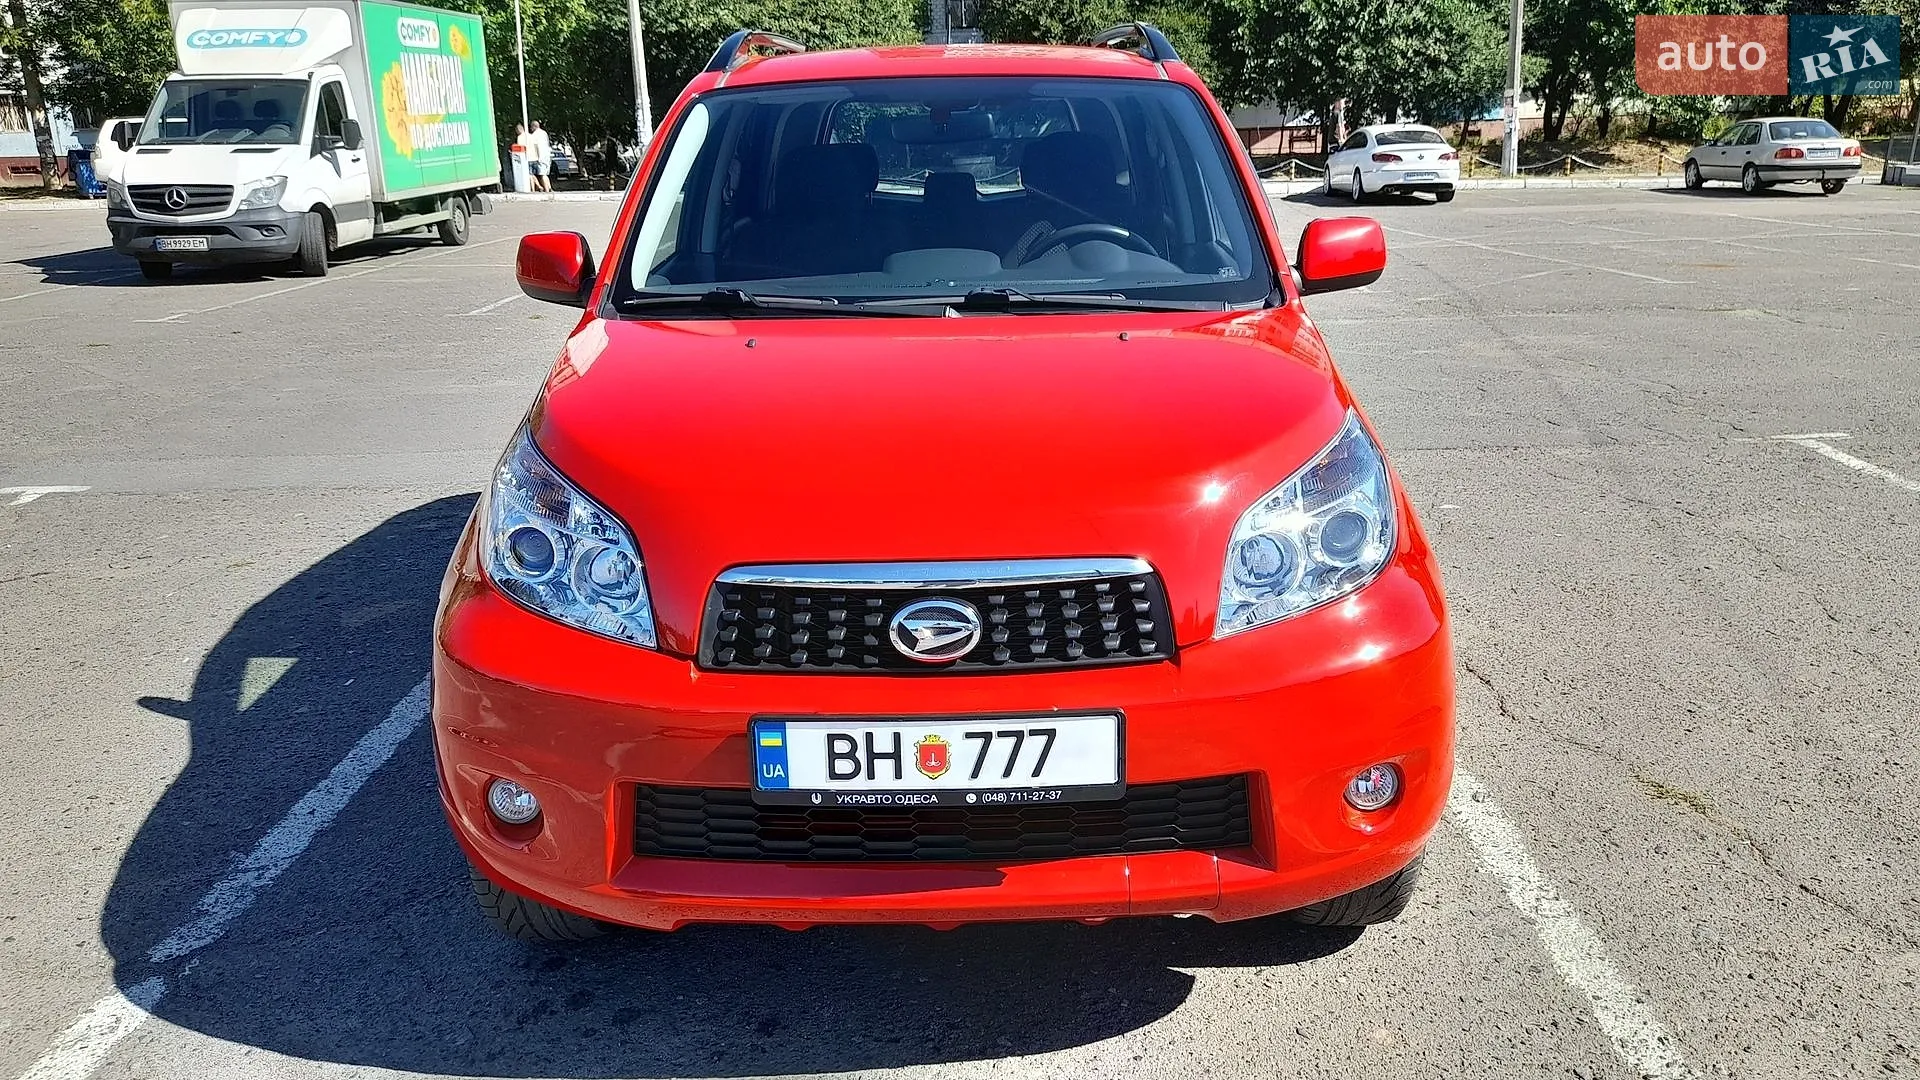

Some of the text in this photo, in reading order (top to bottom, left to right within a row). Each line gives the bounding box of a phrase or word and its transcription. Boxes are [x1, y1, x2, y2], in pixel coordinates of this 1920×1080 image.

[192, 31, 284, 46] COMFY
[400, 22, 431, 43] COMFY
[400, 52, 467, 116] НАМБЕРВАН
[411, 121, 471, 152] ПО ДОСТАВКАМ
[172, 239, 191, 248] 9929
[827, 728, 1057, 781] BH 777
[763, 764, 785, 778] UA
[836, 794, 939, 806] УКРАВТО ОДЕСА
[982, 790, 1062, 804] (048) 711-27-37
